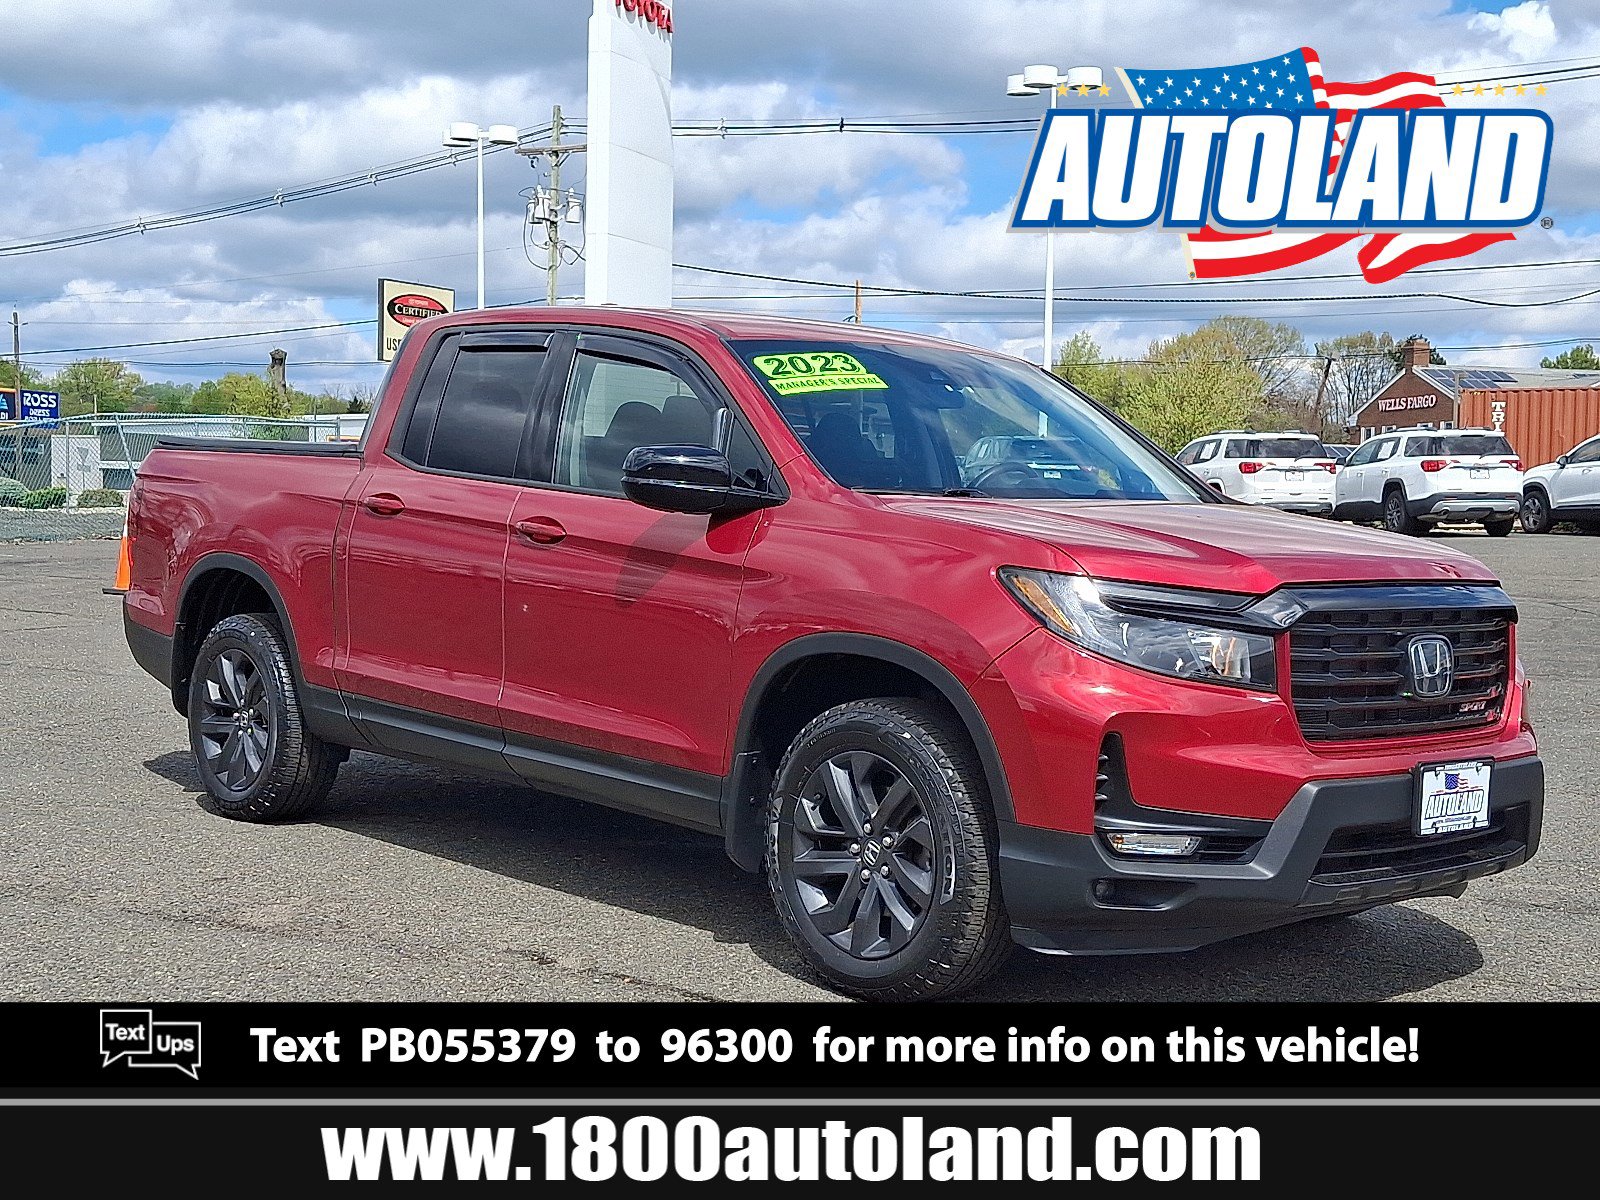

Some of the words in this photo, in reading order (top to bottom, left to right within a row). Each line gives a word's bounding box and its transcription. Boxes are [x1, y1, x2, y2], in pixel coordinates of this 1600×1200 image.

[764, 355, 860, 375] 2023
[775, 378, 836, 390] MANAGER'S
[838, 376, 881, 386] SPECIAL
[23, 393, 57, 408] ROSS
[1378, 398, 1407, 411] WELLS
[1407, 395, 1437, 409] FARGO
[29, 408, 51, 417] DRESS
[1425, 789, 1484, 819] AUTOLAND
